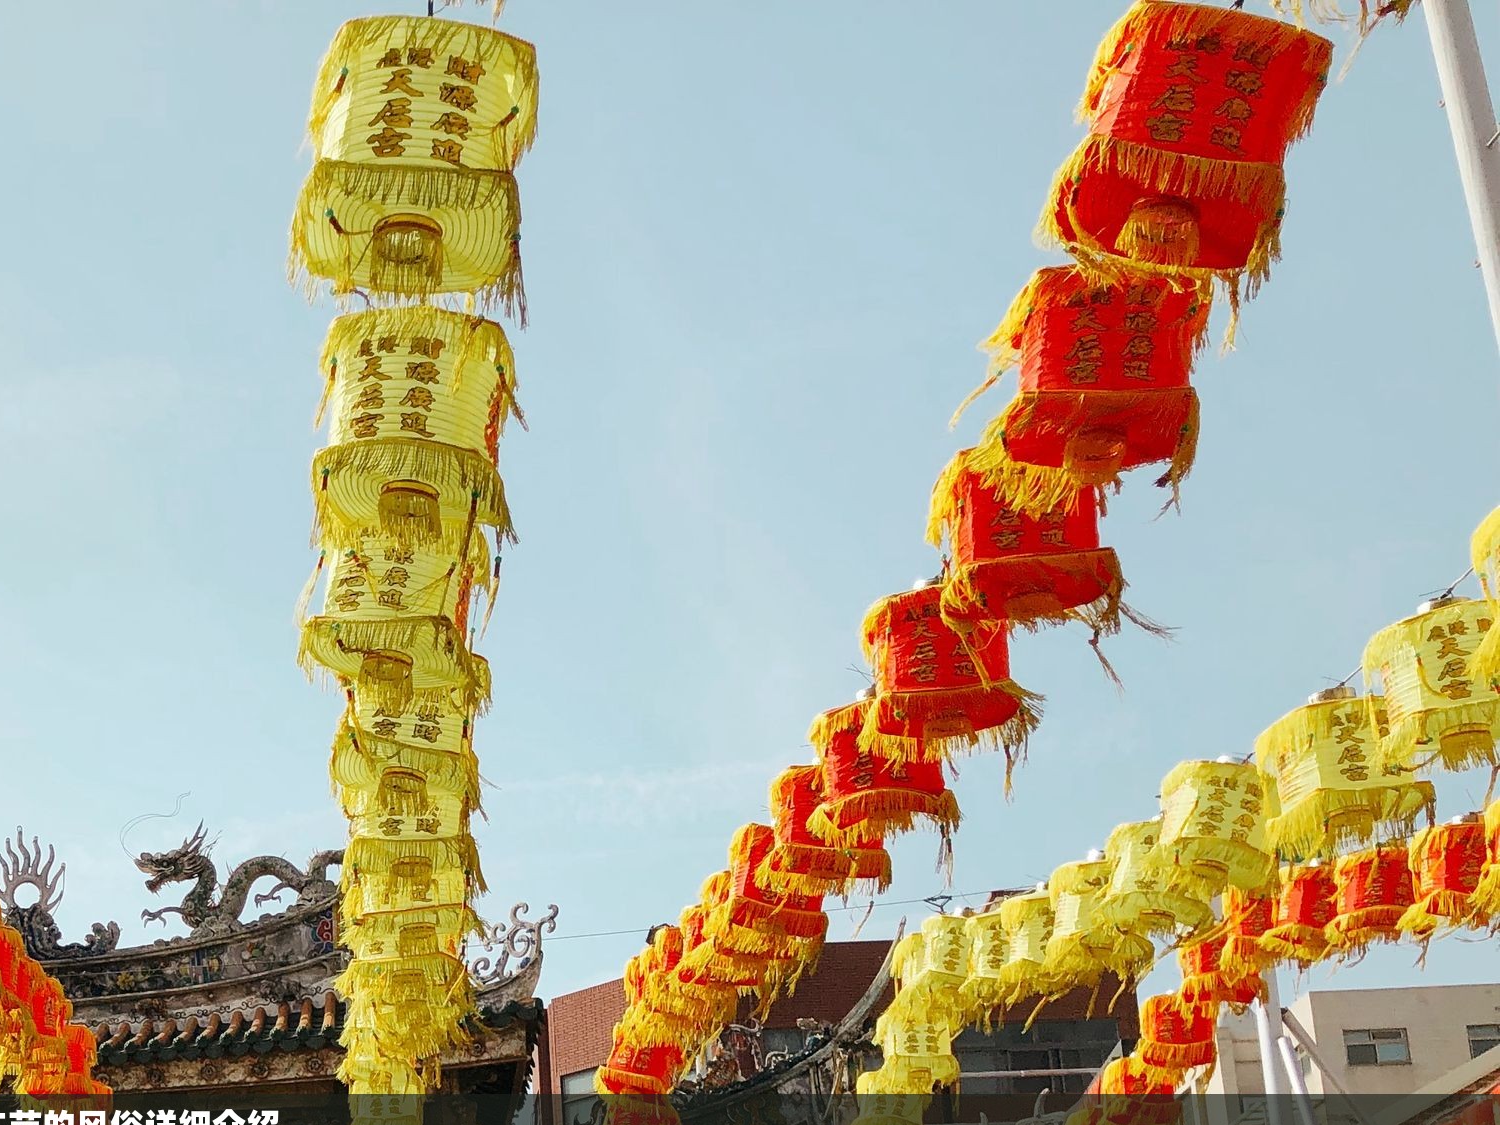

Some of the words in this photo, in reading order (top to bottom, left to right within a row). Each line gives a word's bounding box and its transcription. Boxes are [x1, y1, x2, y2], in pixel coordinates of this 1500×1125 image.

[430, 54, 486, 169] 財源廣進
[399, 336, 446, 438] 財源廣進
